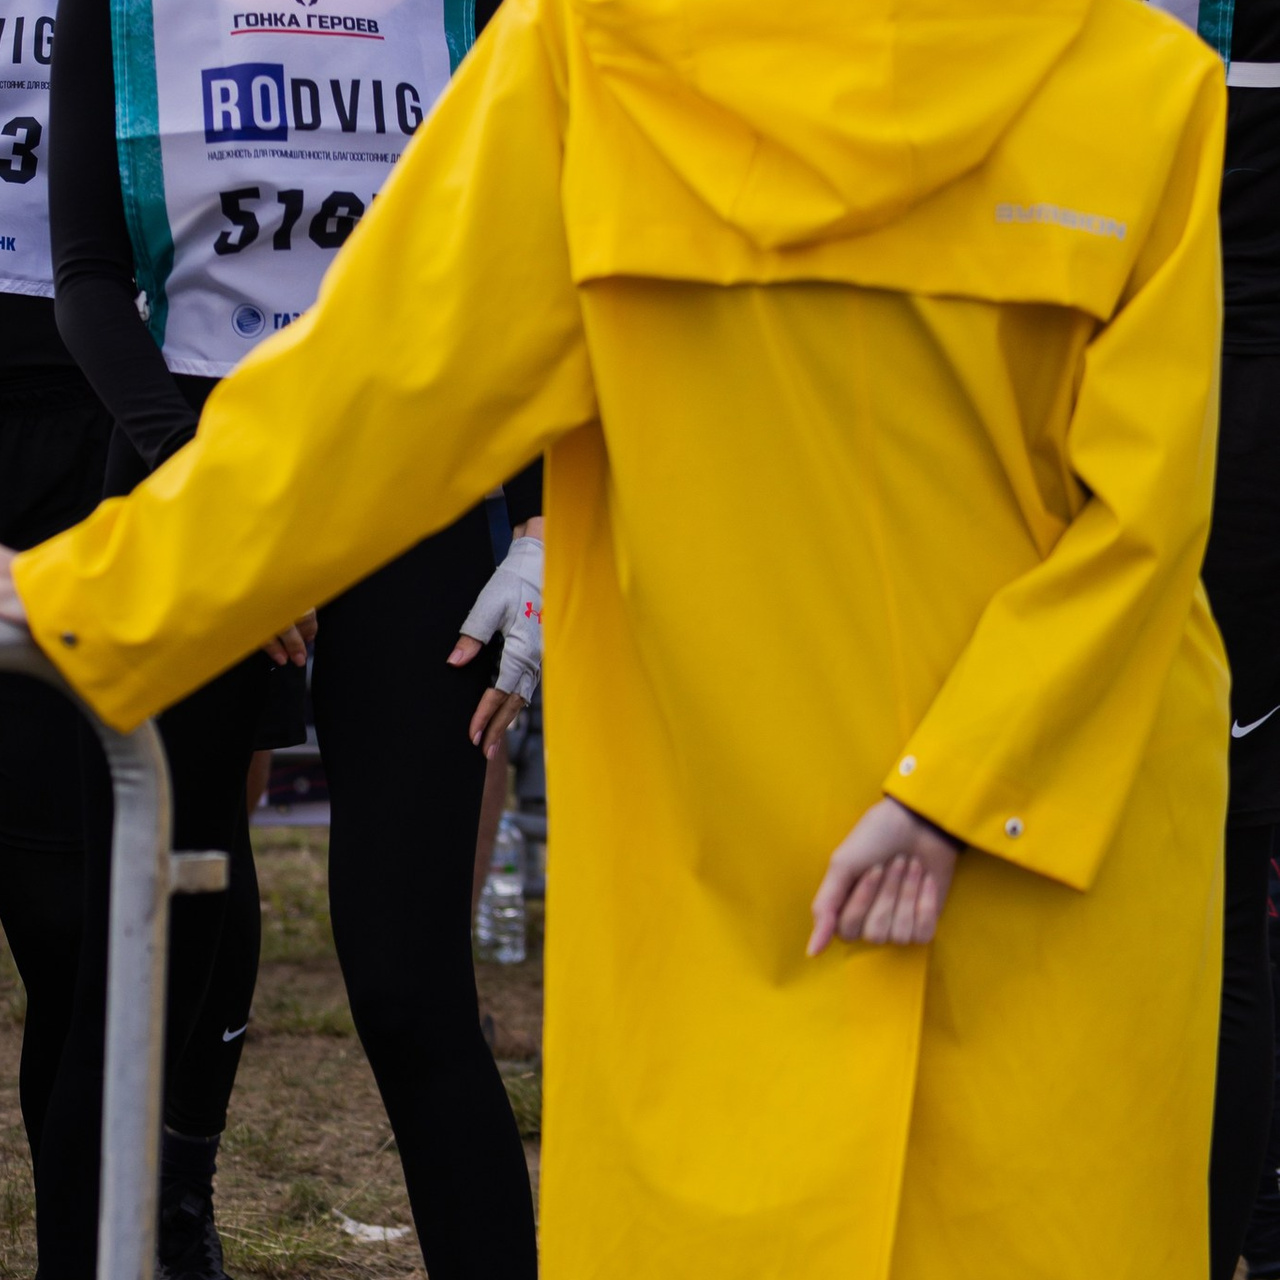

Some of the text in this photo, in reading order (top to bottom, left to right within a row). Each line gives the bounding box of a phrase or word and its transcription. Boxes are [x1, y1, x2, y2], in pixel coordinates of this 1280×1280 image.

[233, 12, 380, 35] ГОНКА ГЕРОЕВ
[209, 74, 424, 136] RODVIG
[213, 186, 379, 256] 516
